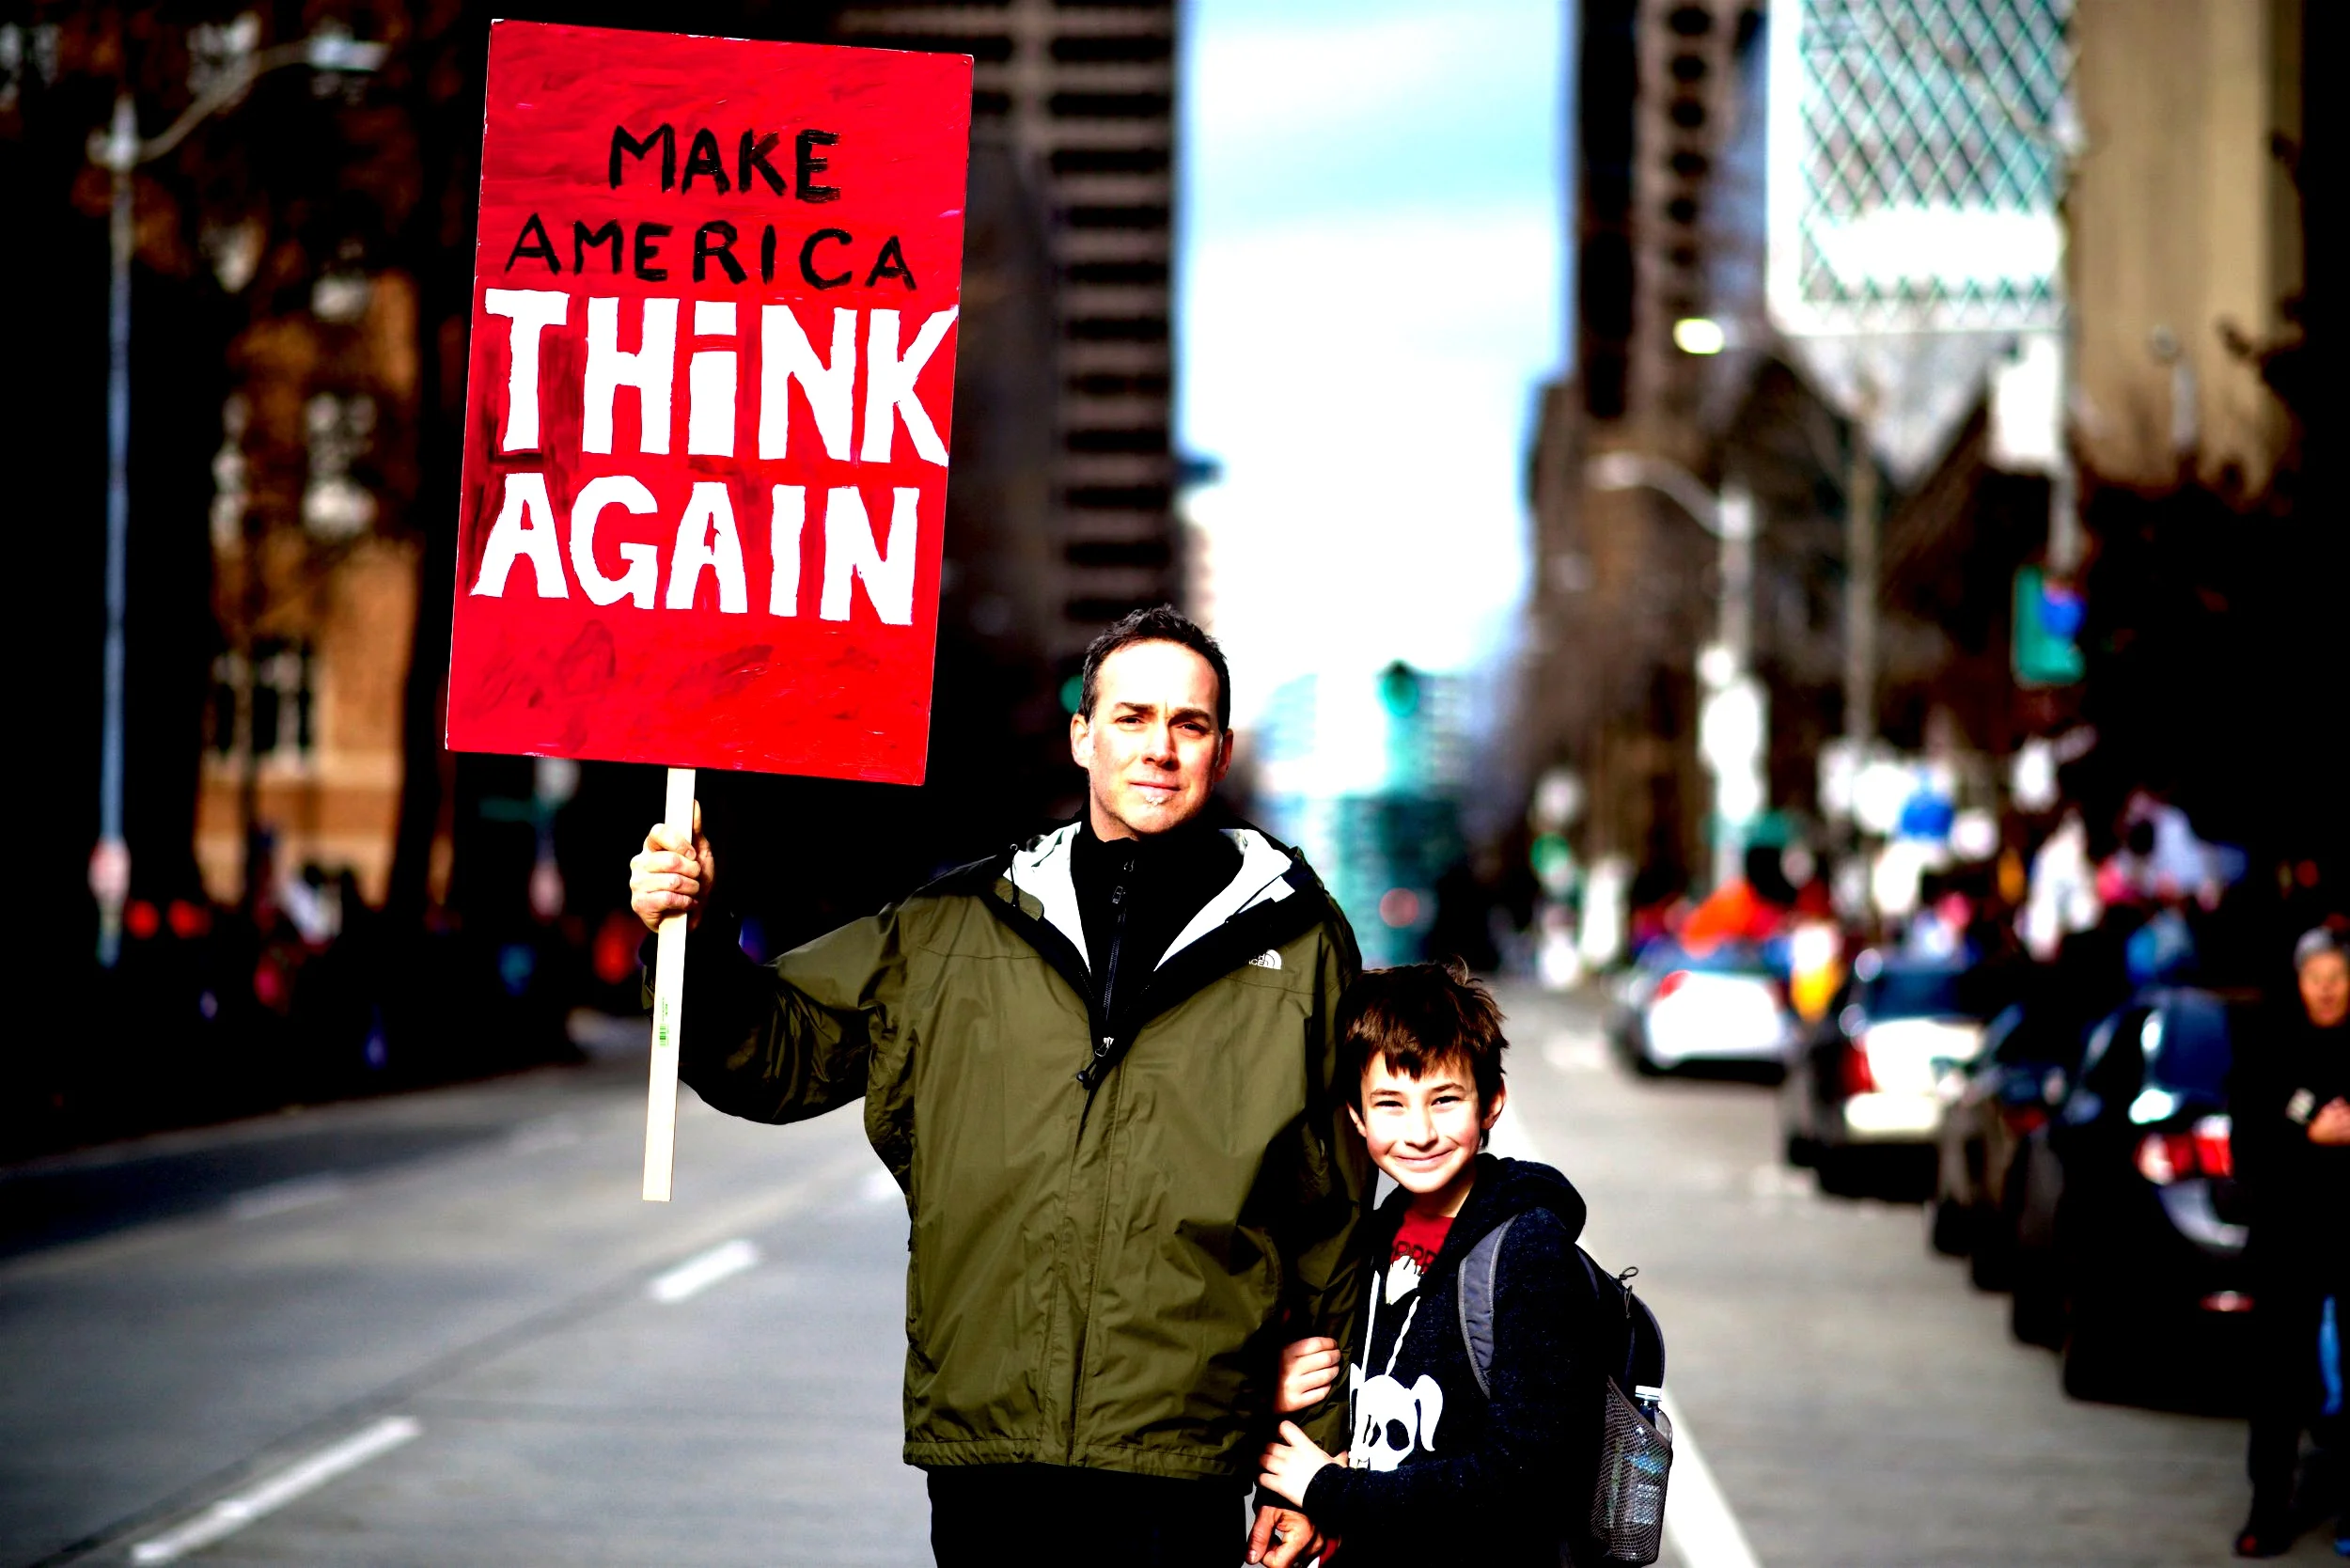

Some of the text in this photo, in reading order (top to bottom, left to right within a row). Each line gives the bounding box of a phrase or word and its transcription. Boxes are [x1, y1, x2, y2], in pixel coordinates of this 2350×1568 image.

[609, 124, 841, 203] MAKE
[505, 212, 917, 290] AMERICA
[470, 472, 920, 625] AGAIN
